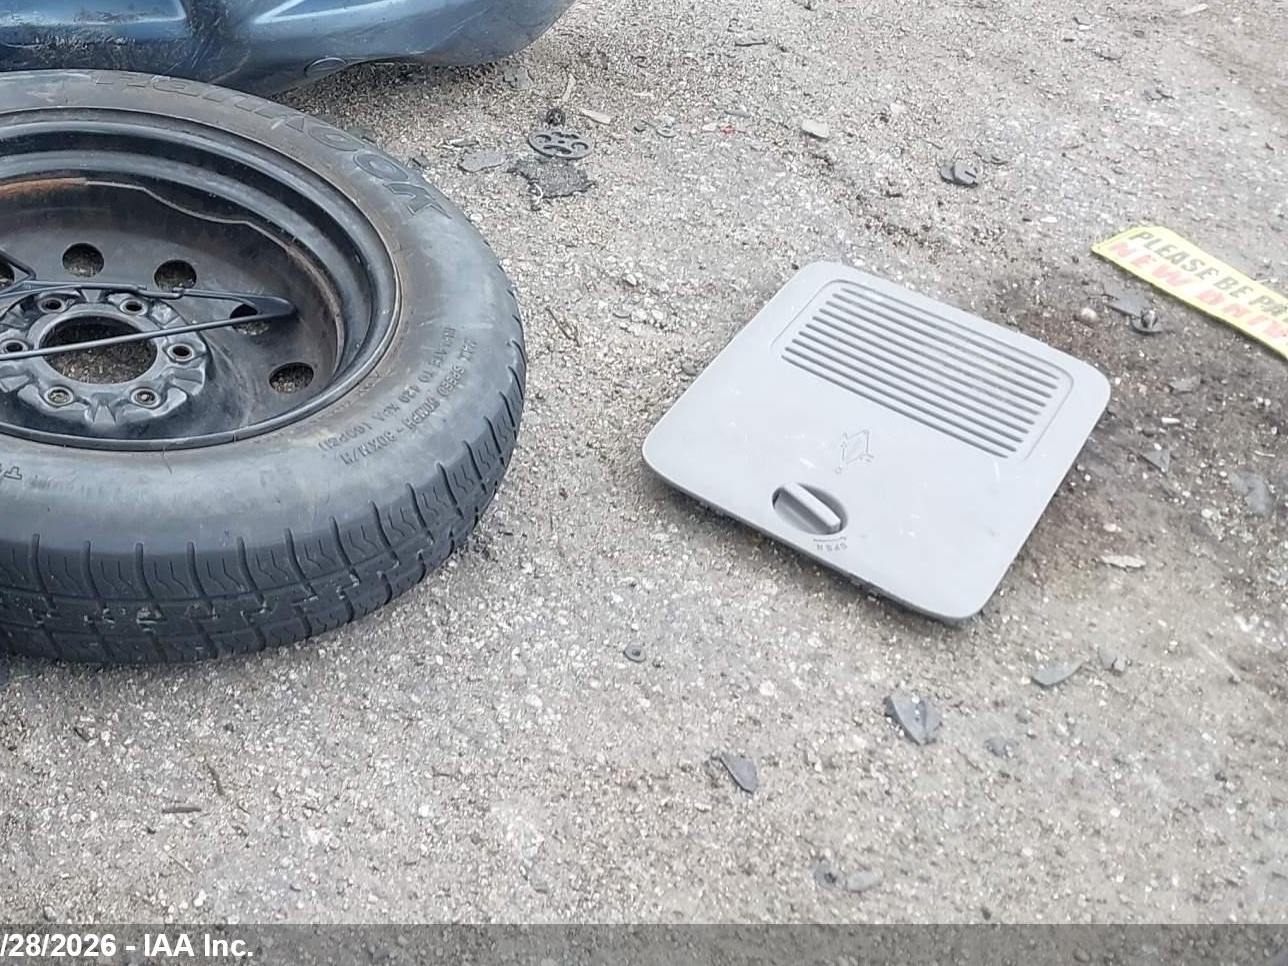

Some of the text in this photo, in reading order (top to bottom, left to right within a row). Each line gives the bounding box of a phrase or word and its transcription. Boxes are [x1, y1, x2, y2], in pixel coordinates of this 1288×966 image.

[1109, 241, 1193, 287] NEW
[1128, 230, 1288, 322] PLEASE BE PA
[436, 362, 466, 398] SPEED
